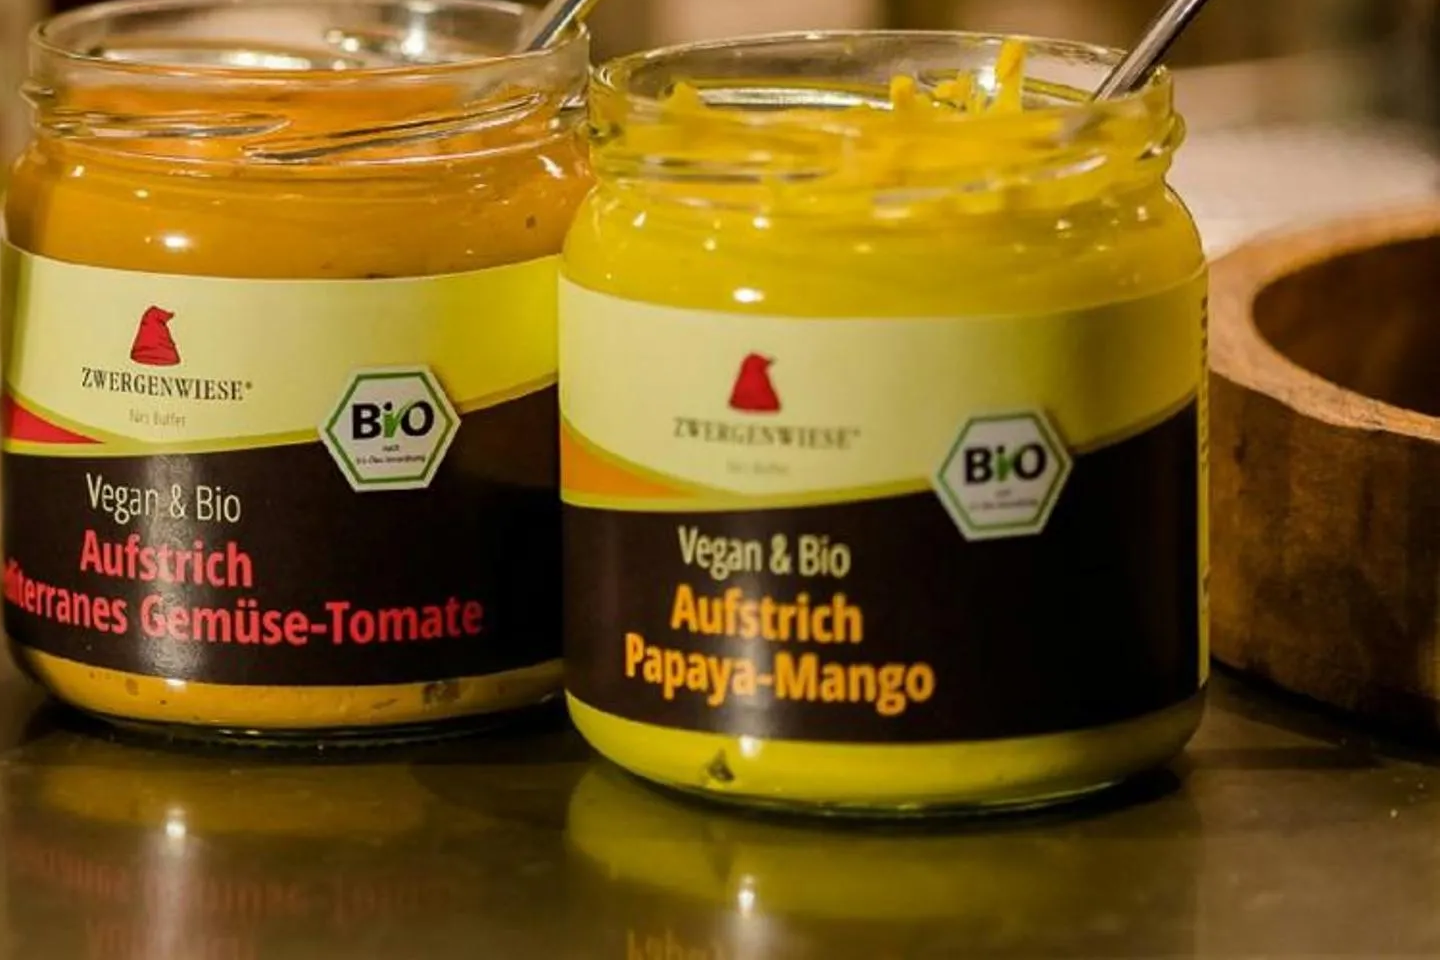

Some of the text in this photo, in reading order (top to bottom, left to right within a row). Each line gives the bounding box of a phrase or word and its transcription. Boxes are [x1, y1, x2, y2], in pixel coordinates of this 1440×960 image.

[81, 367, 245, 401] ZWERGENWIESE
[85, 472, 242, 525] Vegan & Bio
[79, 529, 254, 587] Aufstrich
[677, 525, 852, 581] Vegan & Bio
[139, 593, 484, 645] Gemüse-Tomate
[670, 583, 864, 643] Aufstrich
[624, 632, 937, 716] Papaya-Mango
